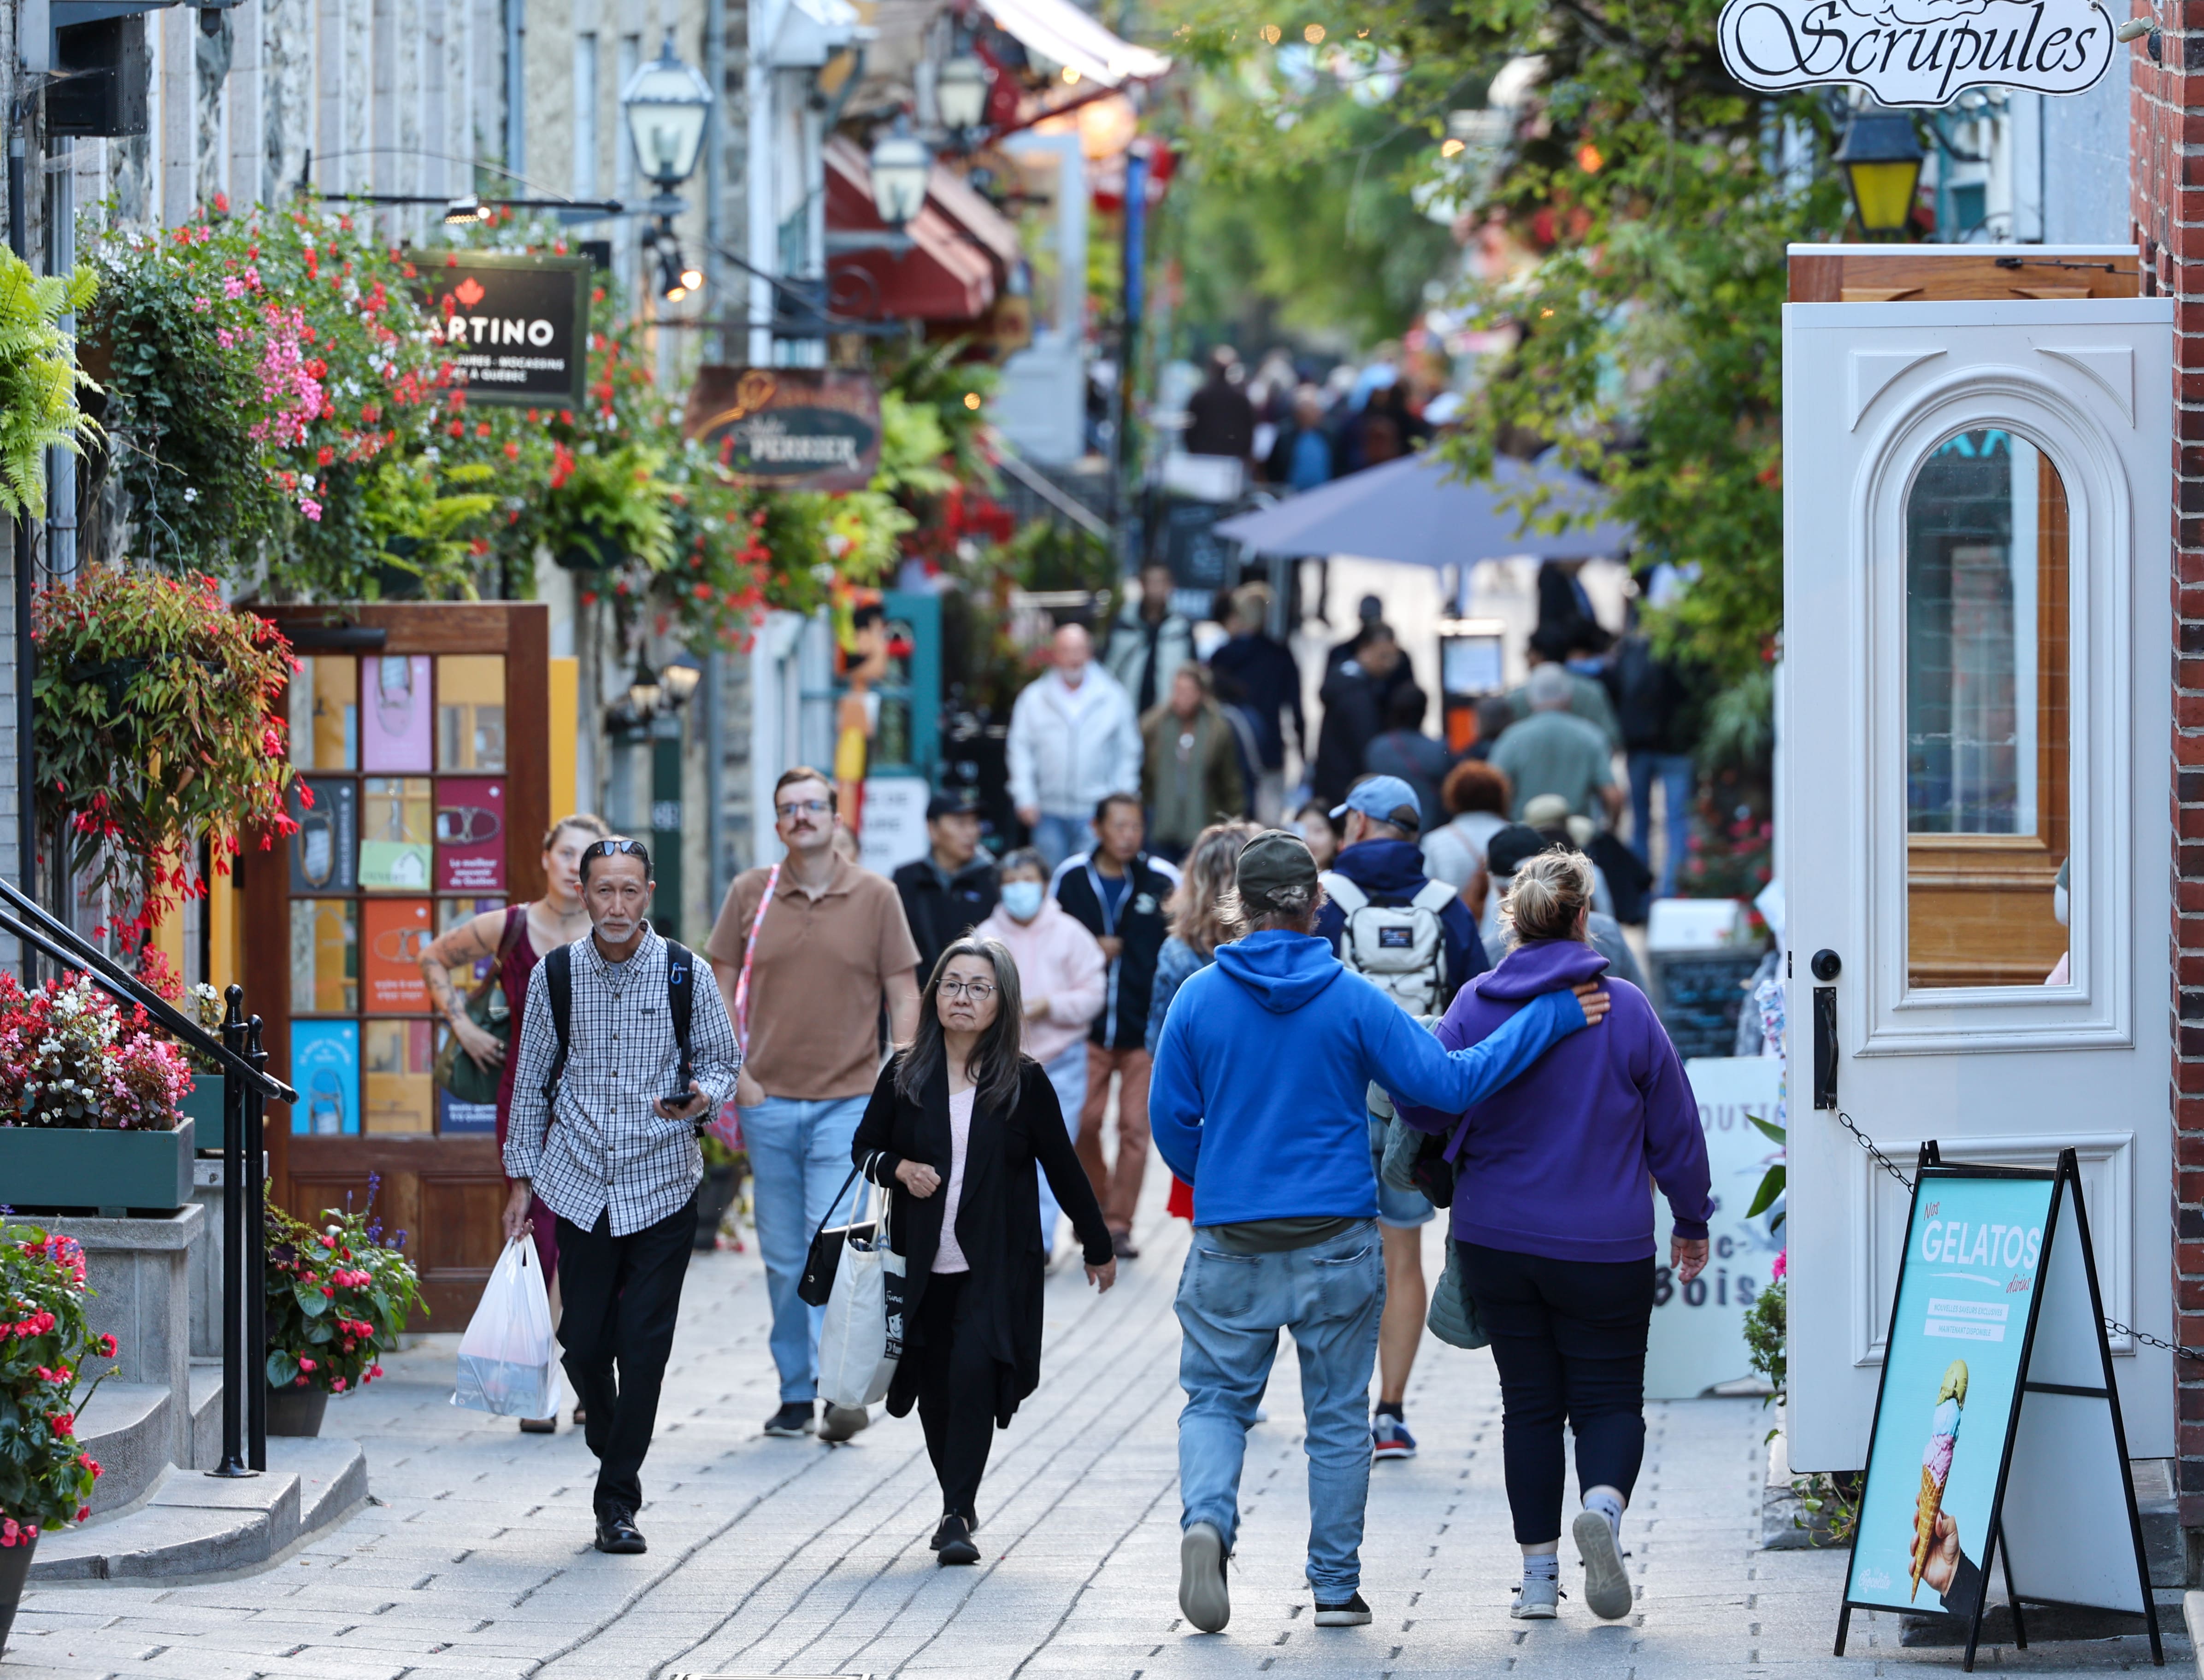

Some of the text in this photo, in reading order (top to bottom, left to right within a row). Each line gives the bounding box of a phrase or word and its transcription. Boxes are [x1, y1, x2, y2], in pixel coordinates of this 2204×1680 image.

[1736, 1, 2097, 99] Scrupules
[425, 315, 554, 347] ARTINO
[1696, 1102, 1781, 1131] OUTI
[1923, 1201, 1940, 1221] Nos
[1921, 1220, 2041, 1269] GELATOS
[1652, 1265, 1757, 1308] Bois
[2006, 1273, 2032, 1294] divins
[1934, 1304, 2003, 1316] NOUVELLES SAVEURS EXCLUSIVES
[1938, 1325, 1992, 1337] MAINTENANT DISPONIBLE
